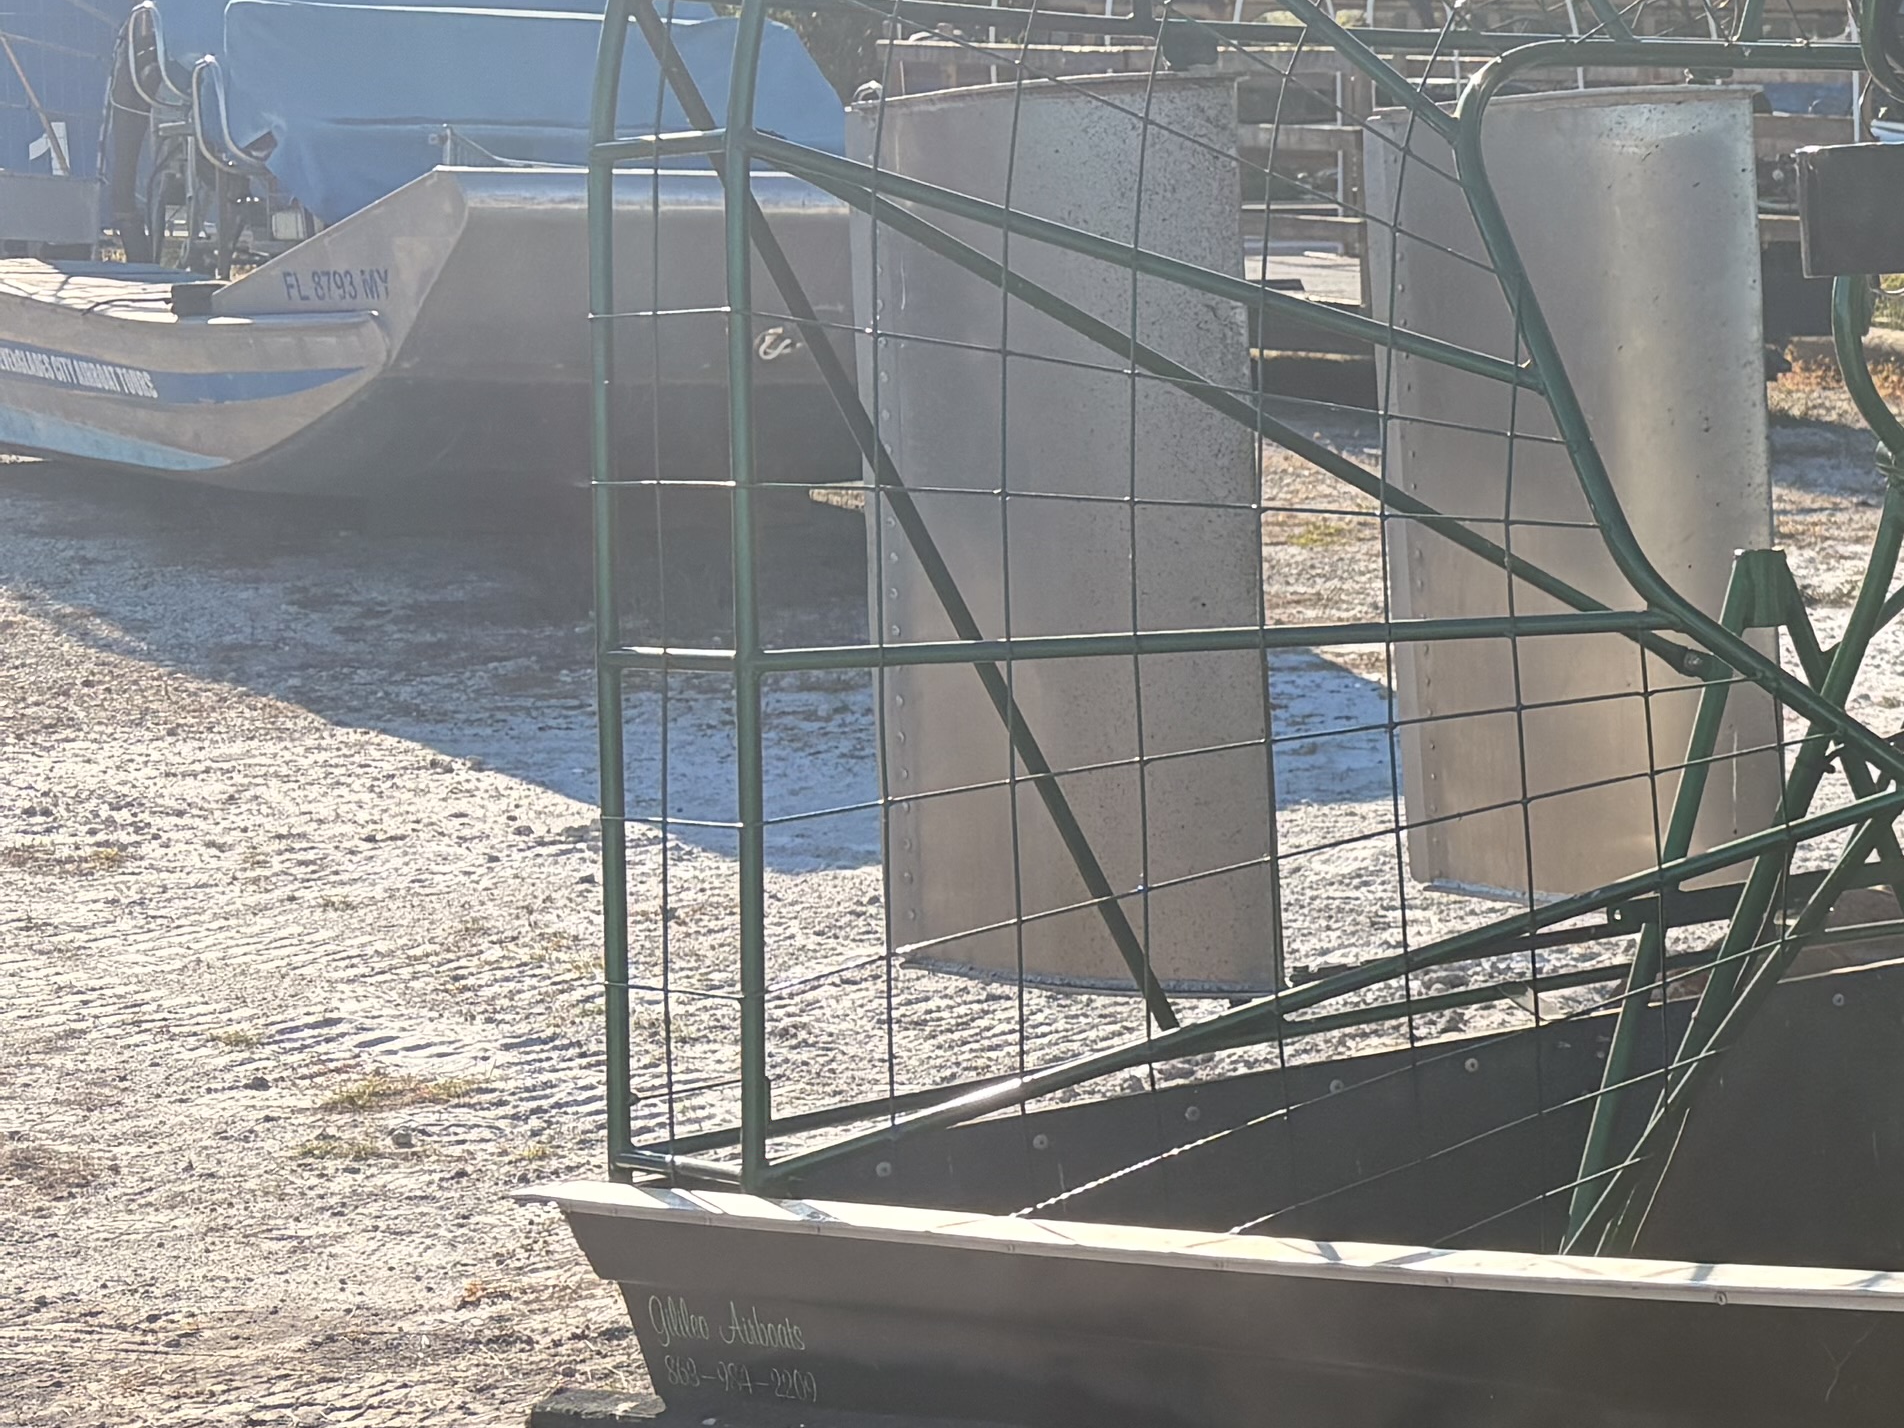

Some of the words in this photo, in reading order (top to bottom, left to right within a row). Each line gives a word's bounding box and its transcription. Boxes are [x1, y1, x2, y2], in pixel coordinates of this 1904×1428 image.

[282, 271, 310, 301] FL
[312, 270, 357, 301] 8793
[360, 268, 389, 300] MY
[51, 355, 78, 384] CITY
[73, 359, 121, 392] AIRBOAT
[115, 366, 158, 399] TOURS
[719, 1300, 805, 1351] Airboats
